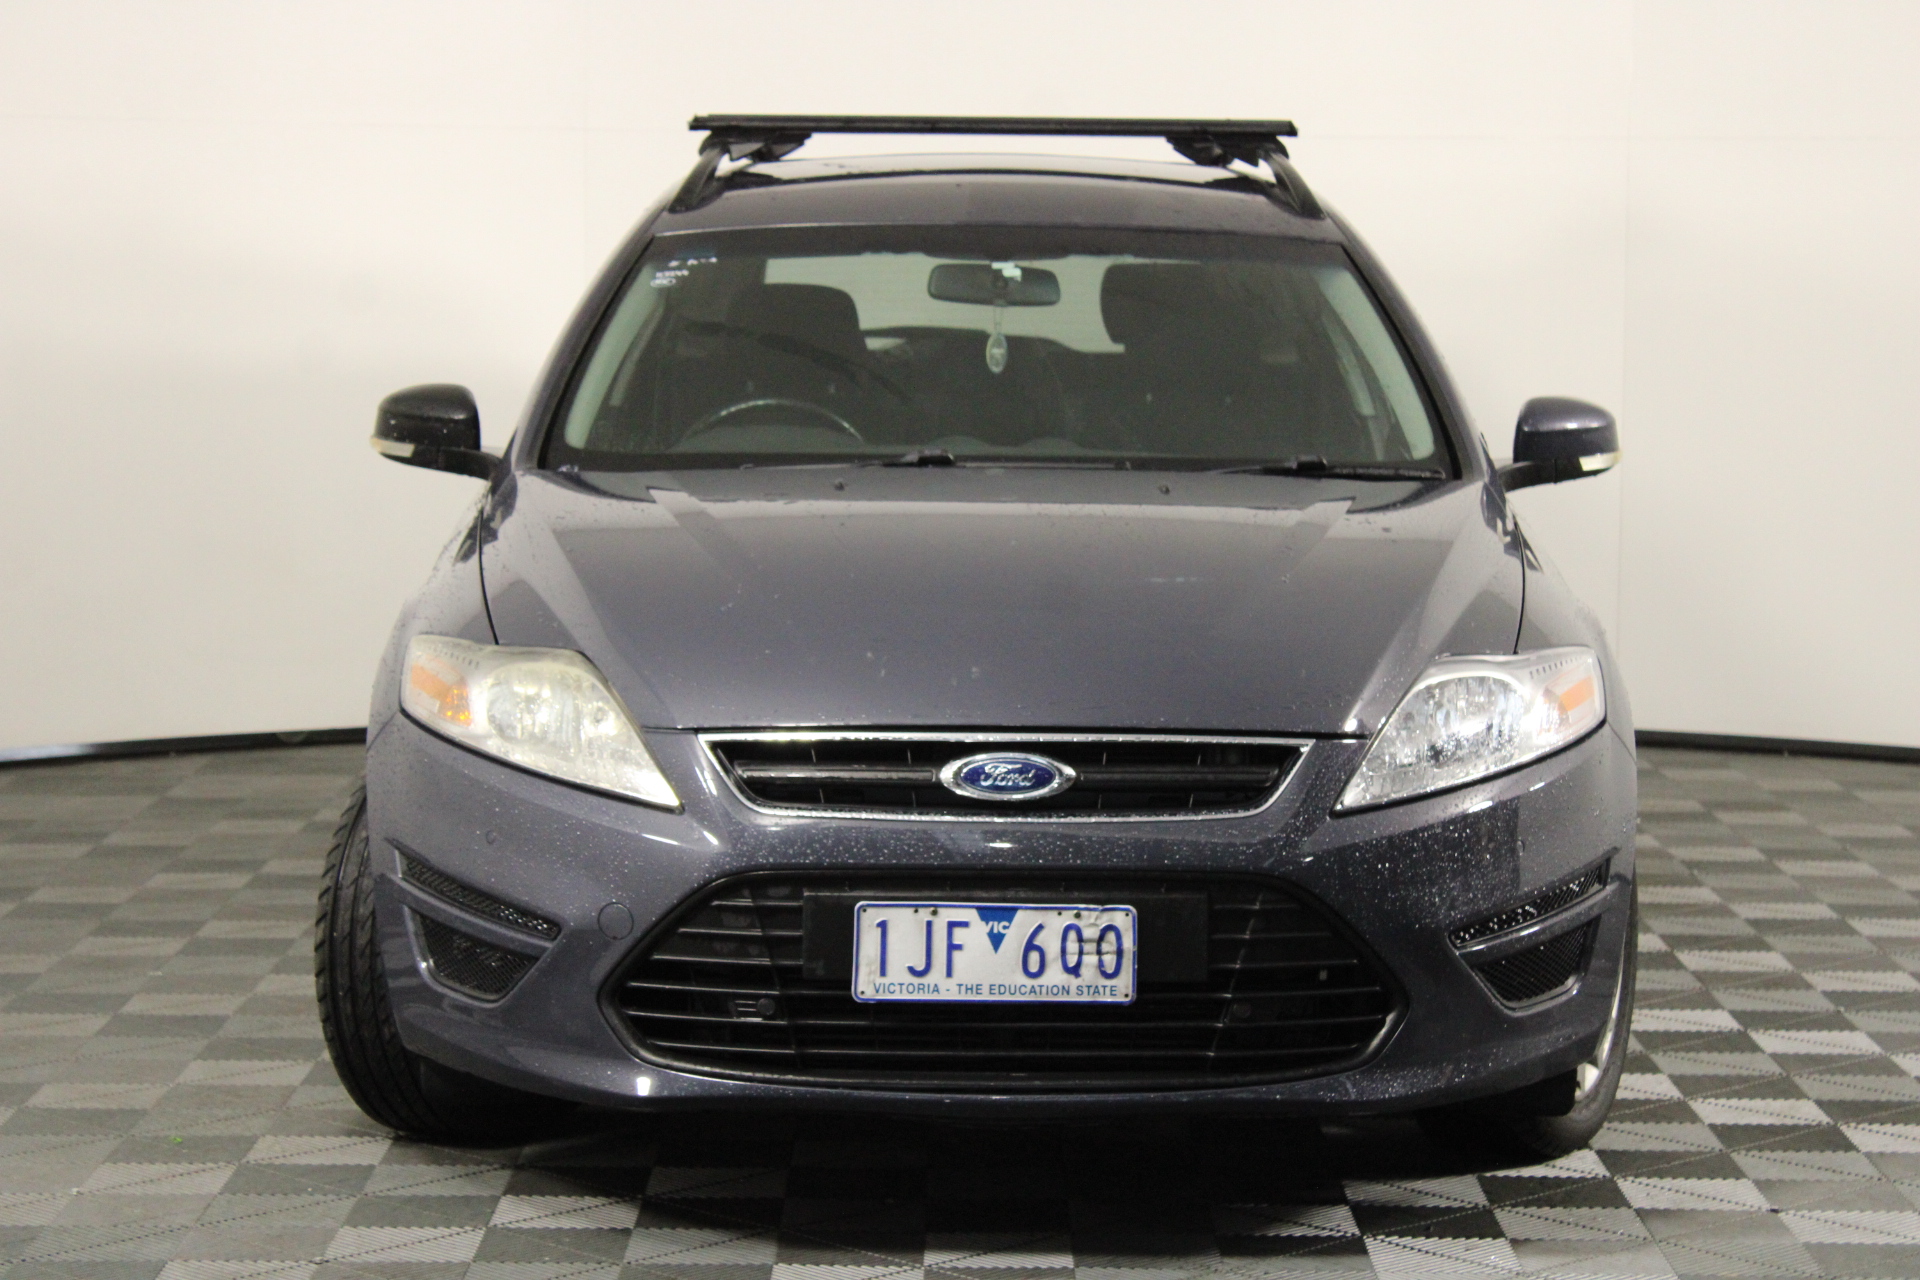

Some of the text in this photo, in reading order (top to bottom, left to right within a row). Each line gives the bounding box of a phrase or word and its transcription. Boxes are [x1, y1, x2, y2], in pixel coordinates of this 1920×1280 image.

[980, 763, 1036, 787] Ford
[985, 921, 1010, 934] VIC
[873, 983, 940, 995] VICTORIA
[956, 984, 983, 995] THE
[989, 984, 1070, 996] EDUCATION
[1076, 985, 1118, 997] STATE
